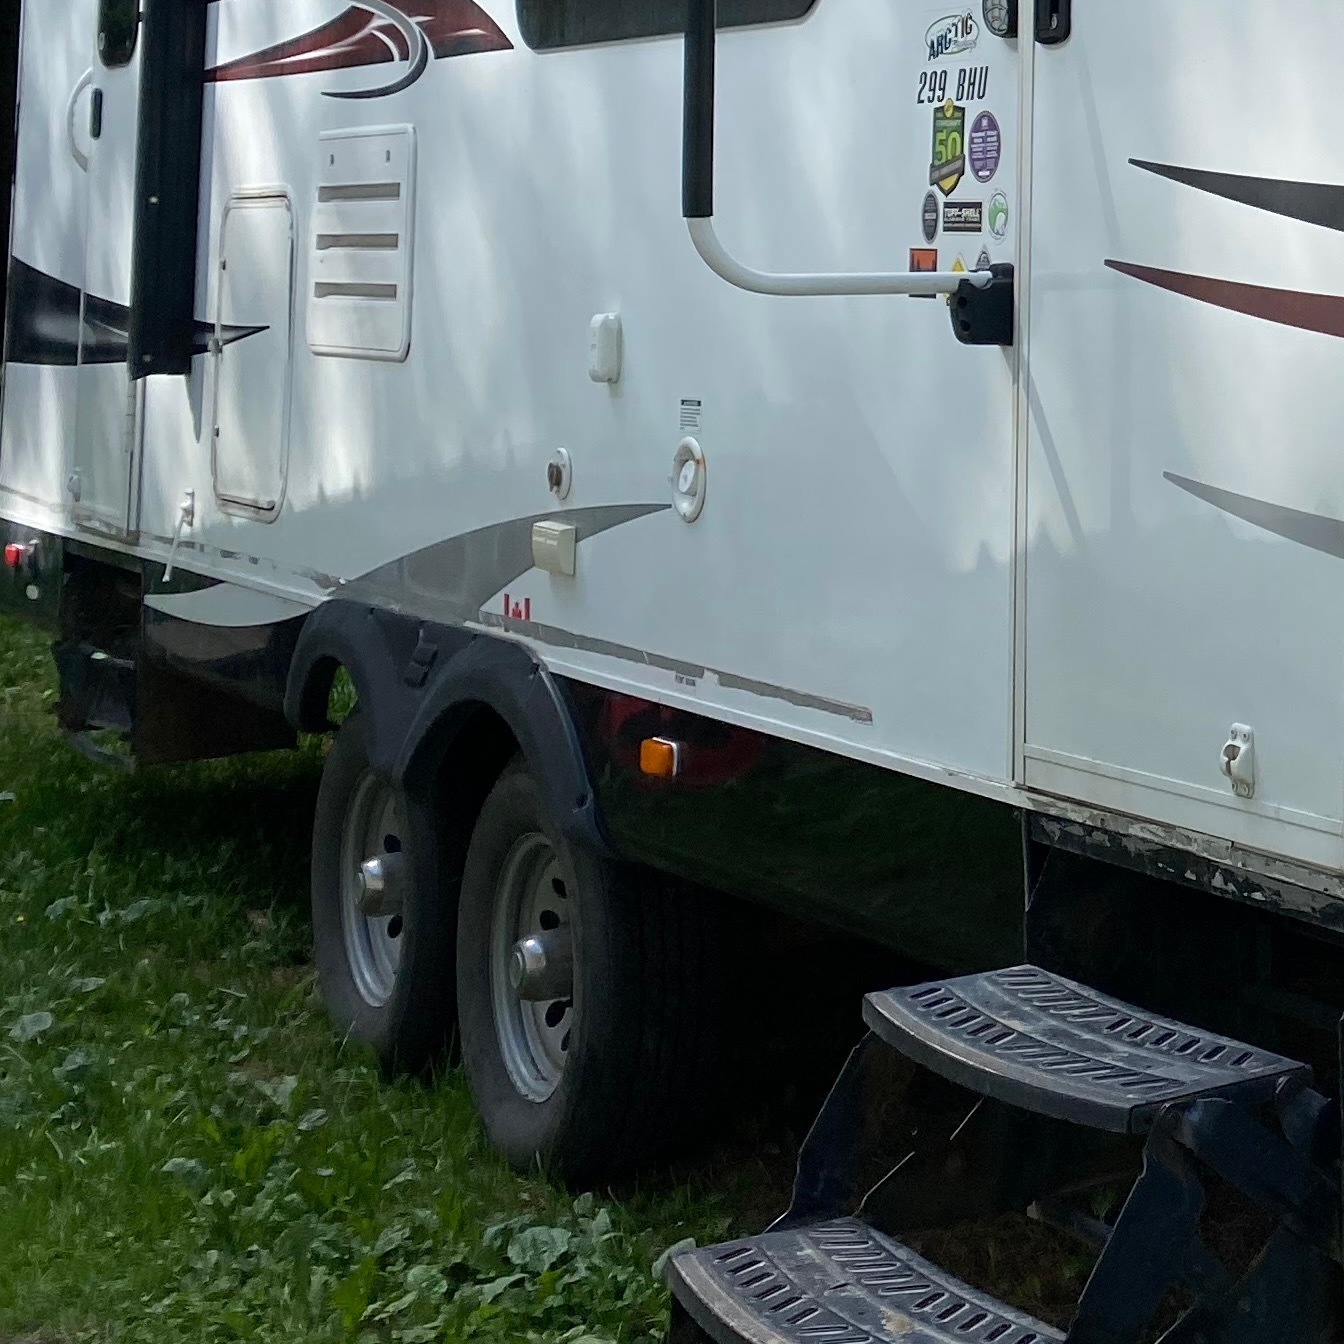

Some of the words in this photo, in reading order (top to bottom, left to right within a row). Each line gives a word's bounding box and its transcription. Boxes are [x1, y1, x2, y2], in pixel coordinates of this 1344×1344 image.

[927, 11, 973, 61] ARCTIC
[917, 69, 948, 104] 299
[956, 66, 989, 102] BHU
[933, 128, 962, 167] 50
